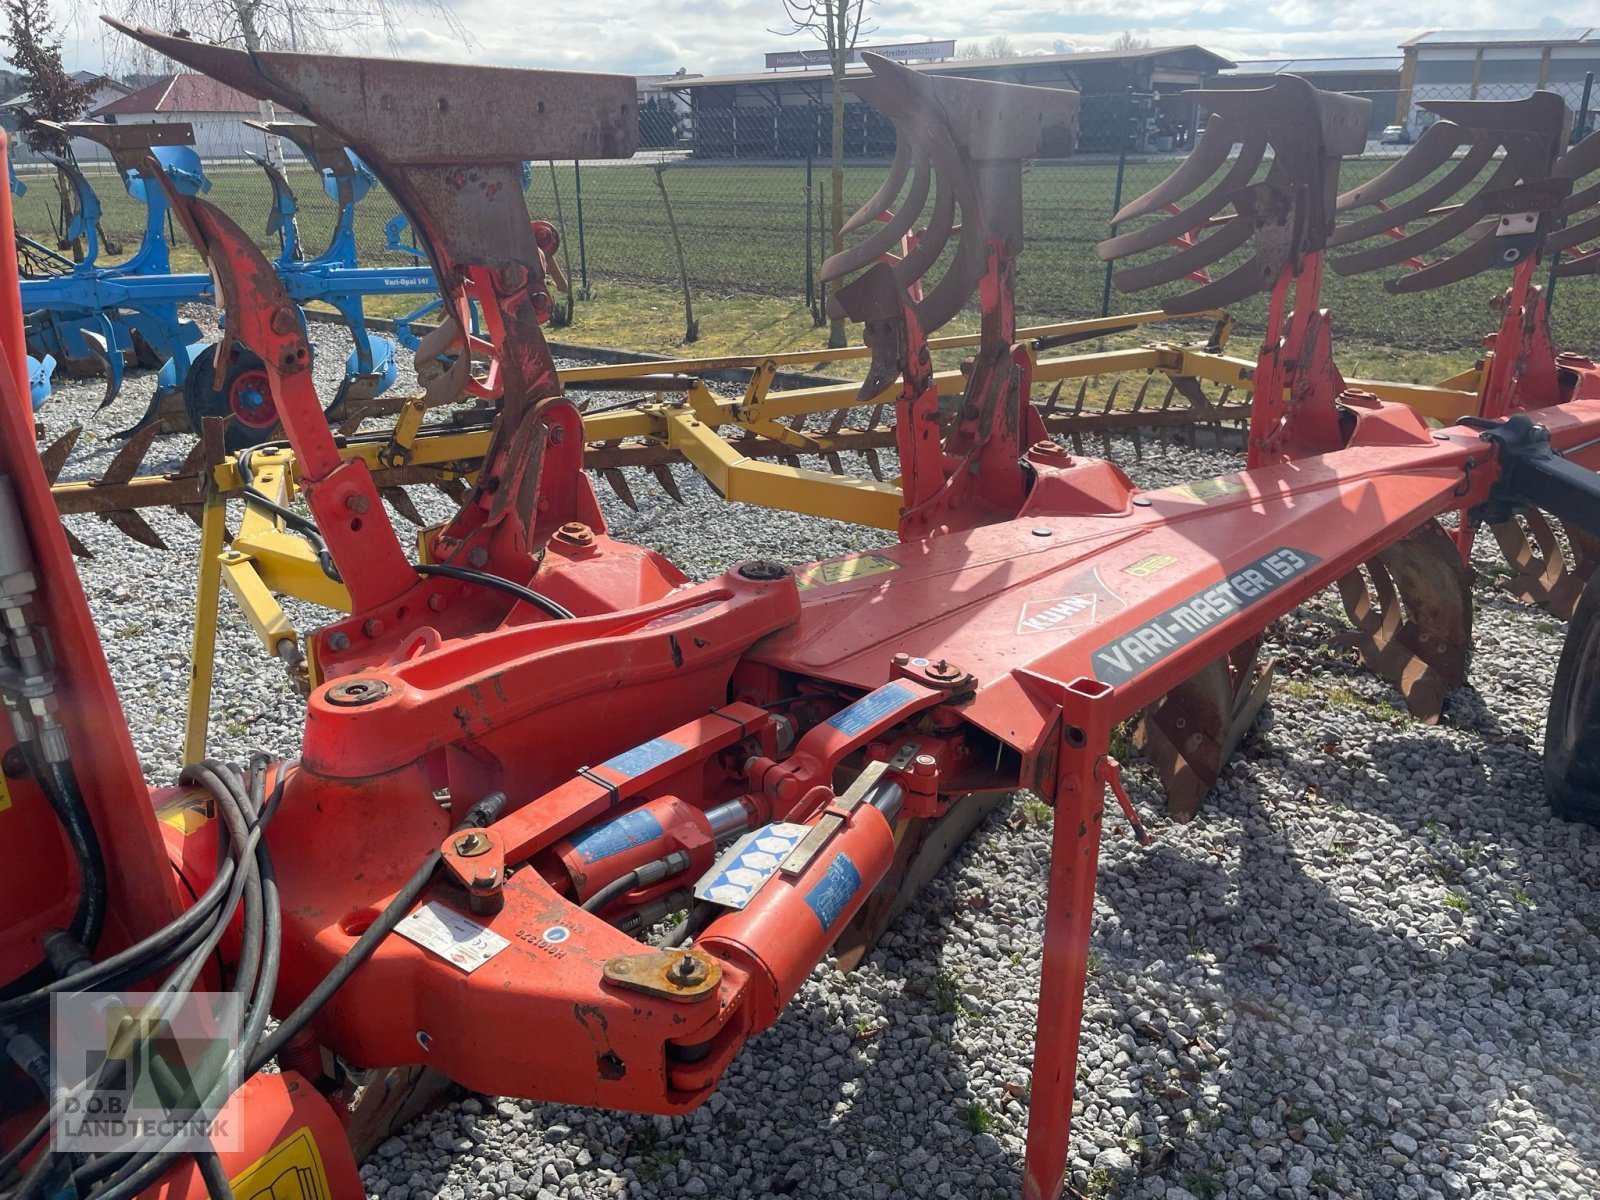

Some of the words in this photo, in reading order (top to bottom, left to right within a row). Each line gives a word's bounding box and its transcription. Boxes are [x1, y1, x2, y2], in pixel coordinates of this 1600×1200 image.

[908, 47, 939, 55] Holzbau
[384, 278, 416, 286] Vari-Opal
[418, 277, 428, 285] 141
[1022, 596, 1094, 631] KUHN
[1097, 567, 1269, 673] VARI-MASTER
[1261, 549, 1307, 580] 153
